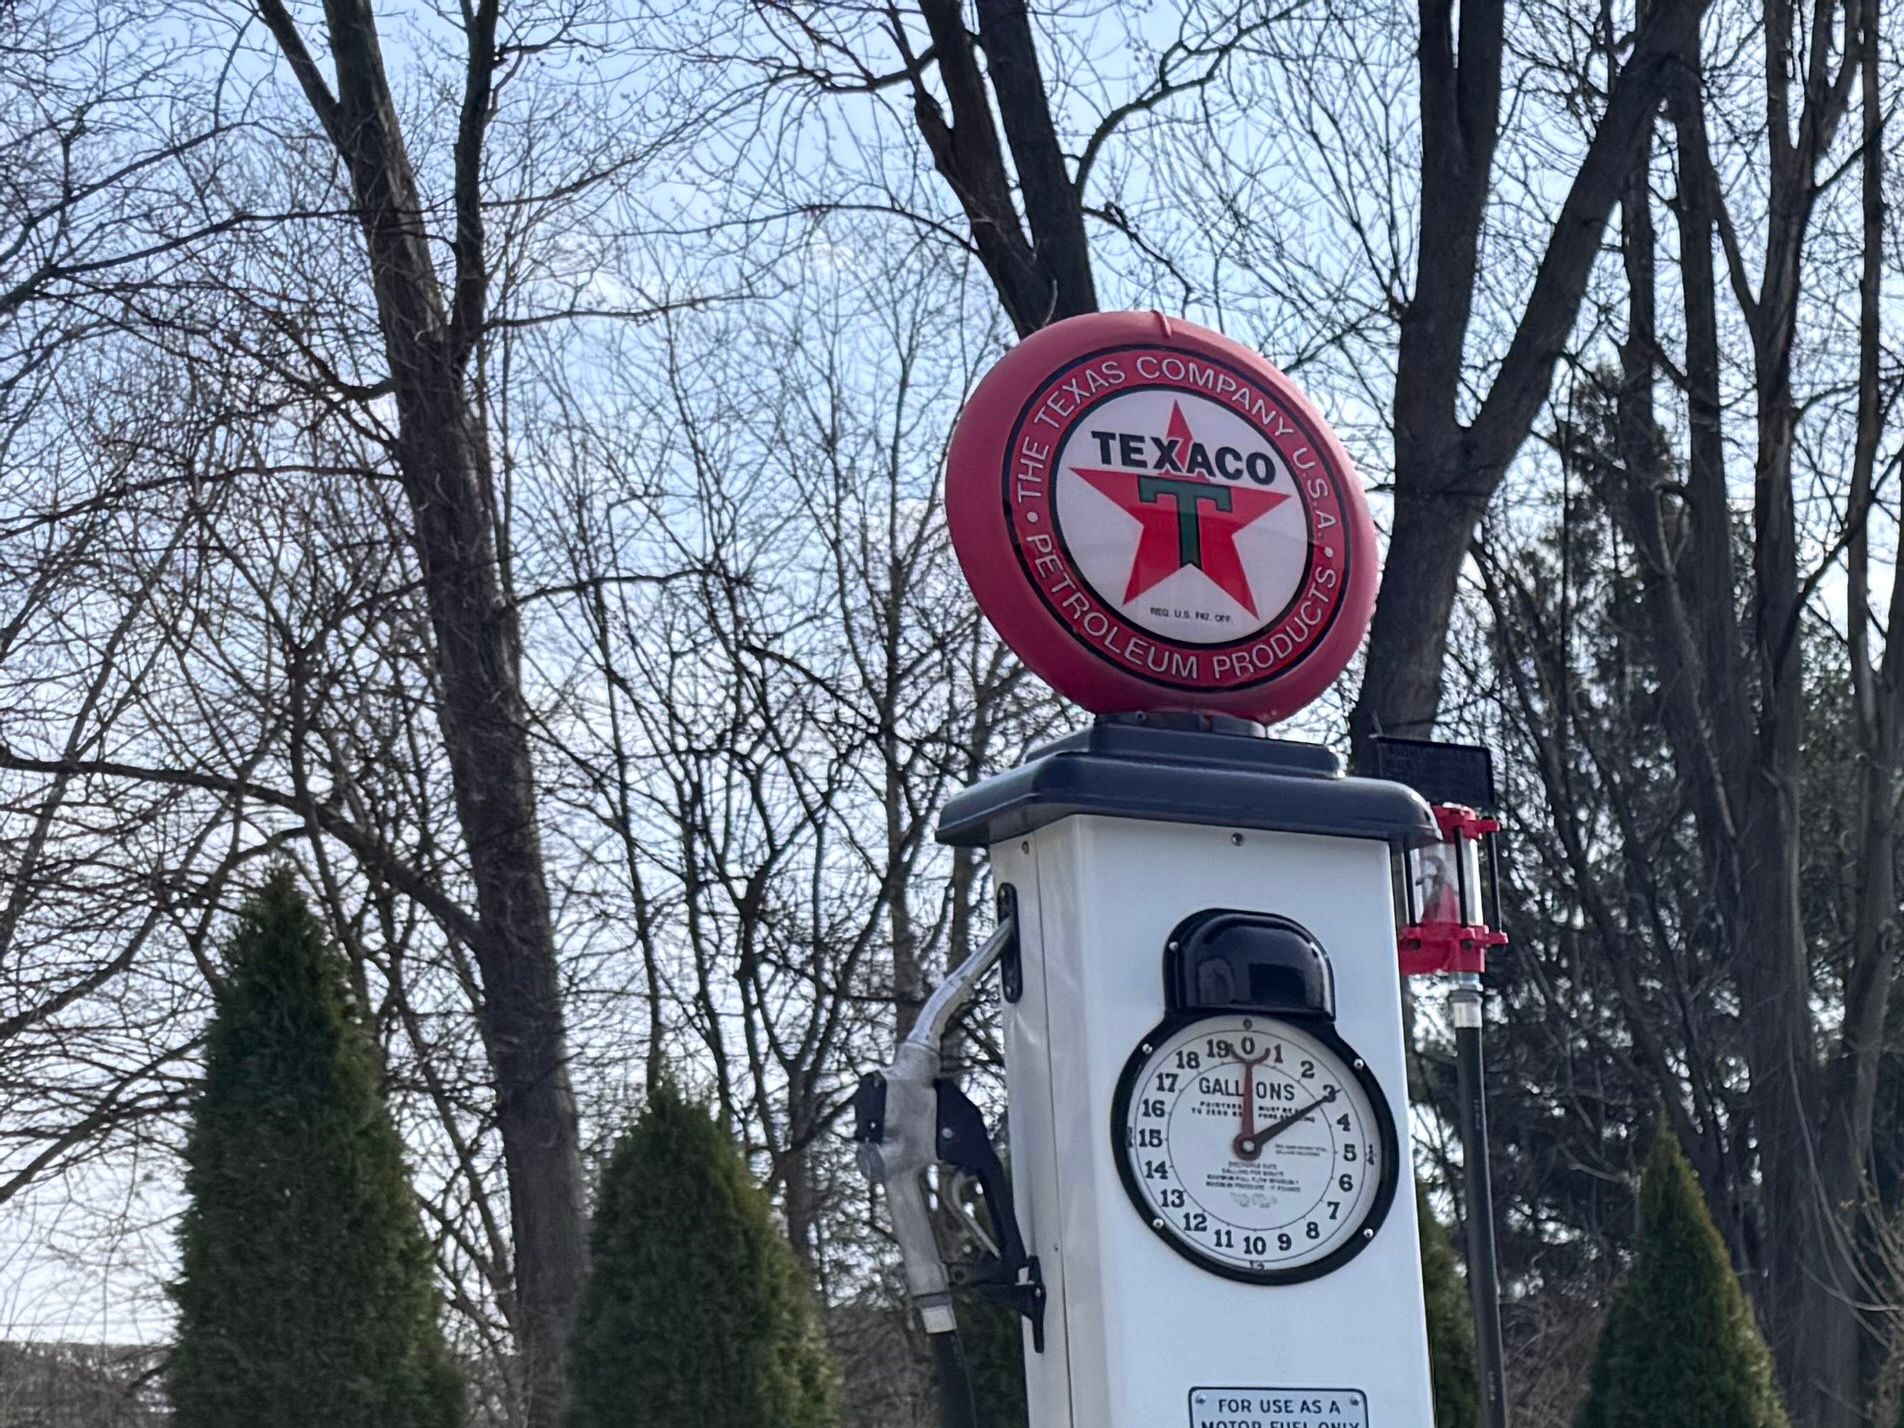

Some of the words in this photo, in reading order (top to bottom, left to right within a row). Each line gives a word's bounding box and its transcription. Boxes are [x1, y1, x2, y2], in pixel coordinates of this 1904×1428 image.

[1033, 361, 1126, 430] TEXAS
[1136, 356, 1295, 437] COMPANY
[1091, 430, 1276, 486] TEXACO
[1018, 437, 1049, 503] THE
[1137, 475, 1233, 568] T
[1026, 534, 1199, 679] PETROLEUM
[1212, 565, 1337, 680] PRODUCTS
[1207, 1039, 1230, 1058] 19
[1241, 1037, 1255, 1055] 0
[1274, 1044, 1283, 1063] 1
[1176, 1050, 1200, 1069] 18
[1301, 1060, 1315, 1079] 2
[1156, 1072, 1179, 1092] 17
[1199, 1077, 1295, 1101] GALLONS
[1142, 1098, 1165, 1118] 16
[1337, 1113, 1351, 1132] 4
[1139, 1128, 1163, 1147] 15
[1343, 1144, 1357, 1161] 5
[1145, 1160, 1168, 1179] 14
[1339, 1173, 1353, 1192] 6
[1161, 1189, 1185, 1208] 13
[1327, 1201, 1340, 1220] 7
[1183, 1212, 1207, 1232] 12
[1306, 1221, 1320, 1239] 8
[1215, 1229, 1234, 1248] 11
[1243, 1236, 1266, 1255] 10
[1278, 1233, 1291, 1251] 9
[1218, 1399, 1252, 1414] FOR
[1259, 1399, 1294, 1414] USE
[1300, 1400, 1322, 1414] AS
[1329, 1400, 1341, 1414] A
